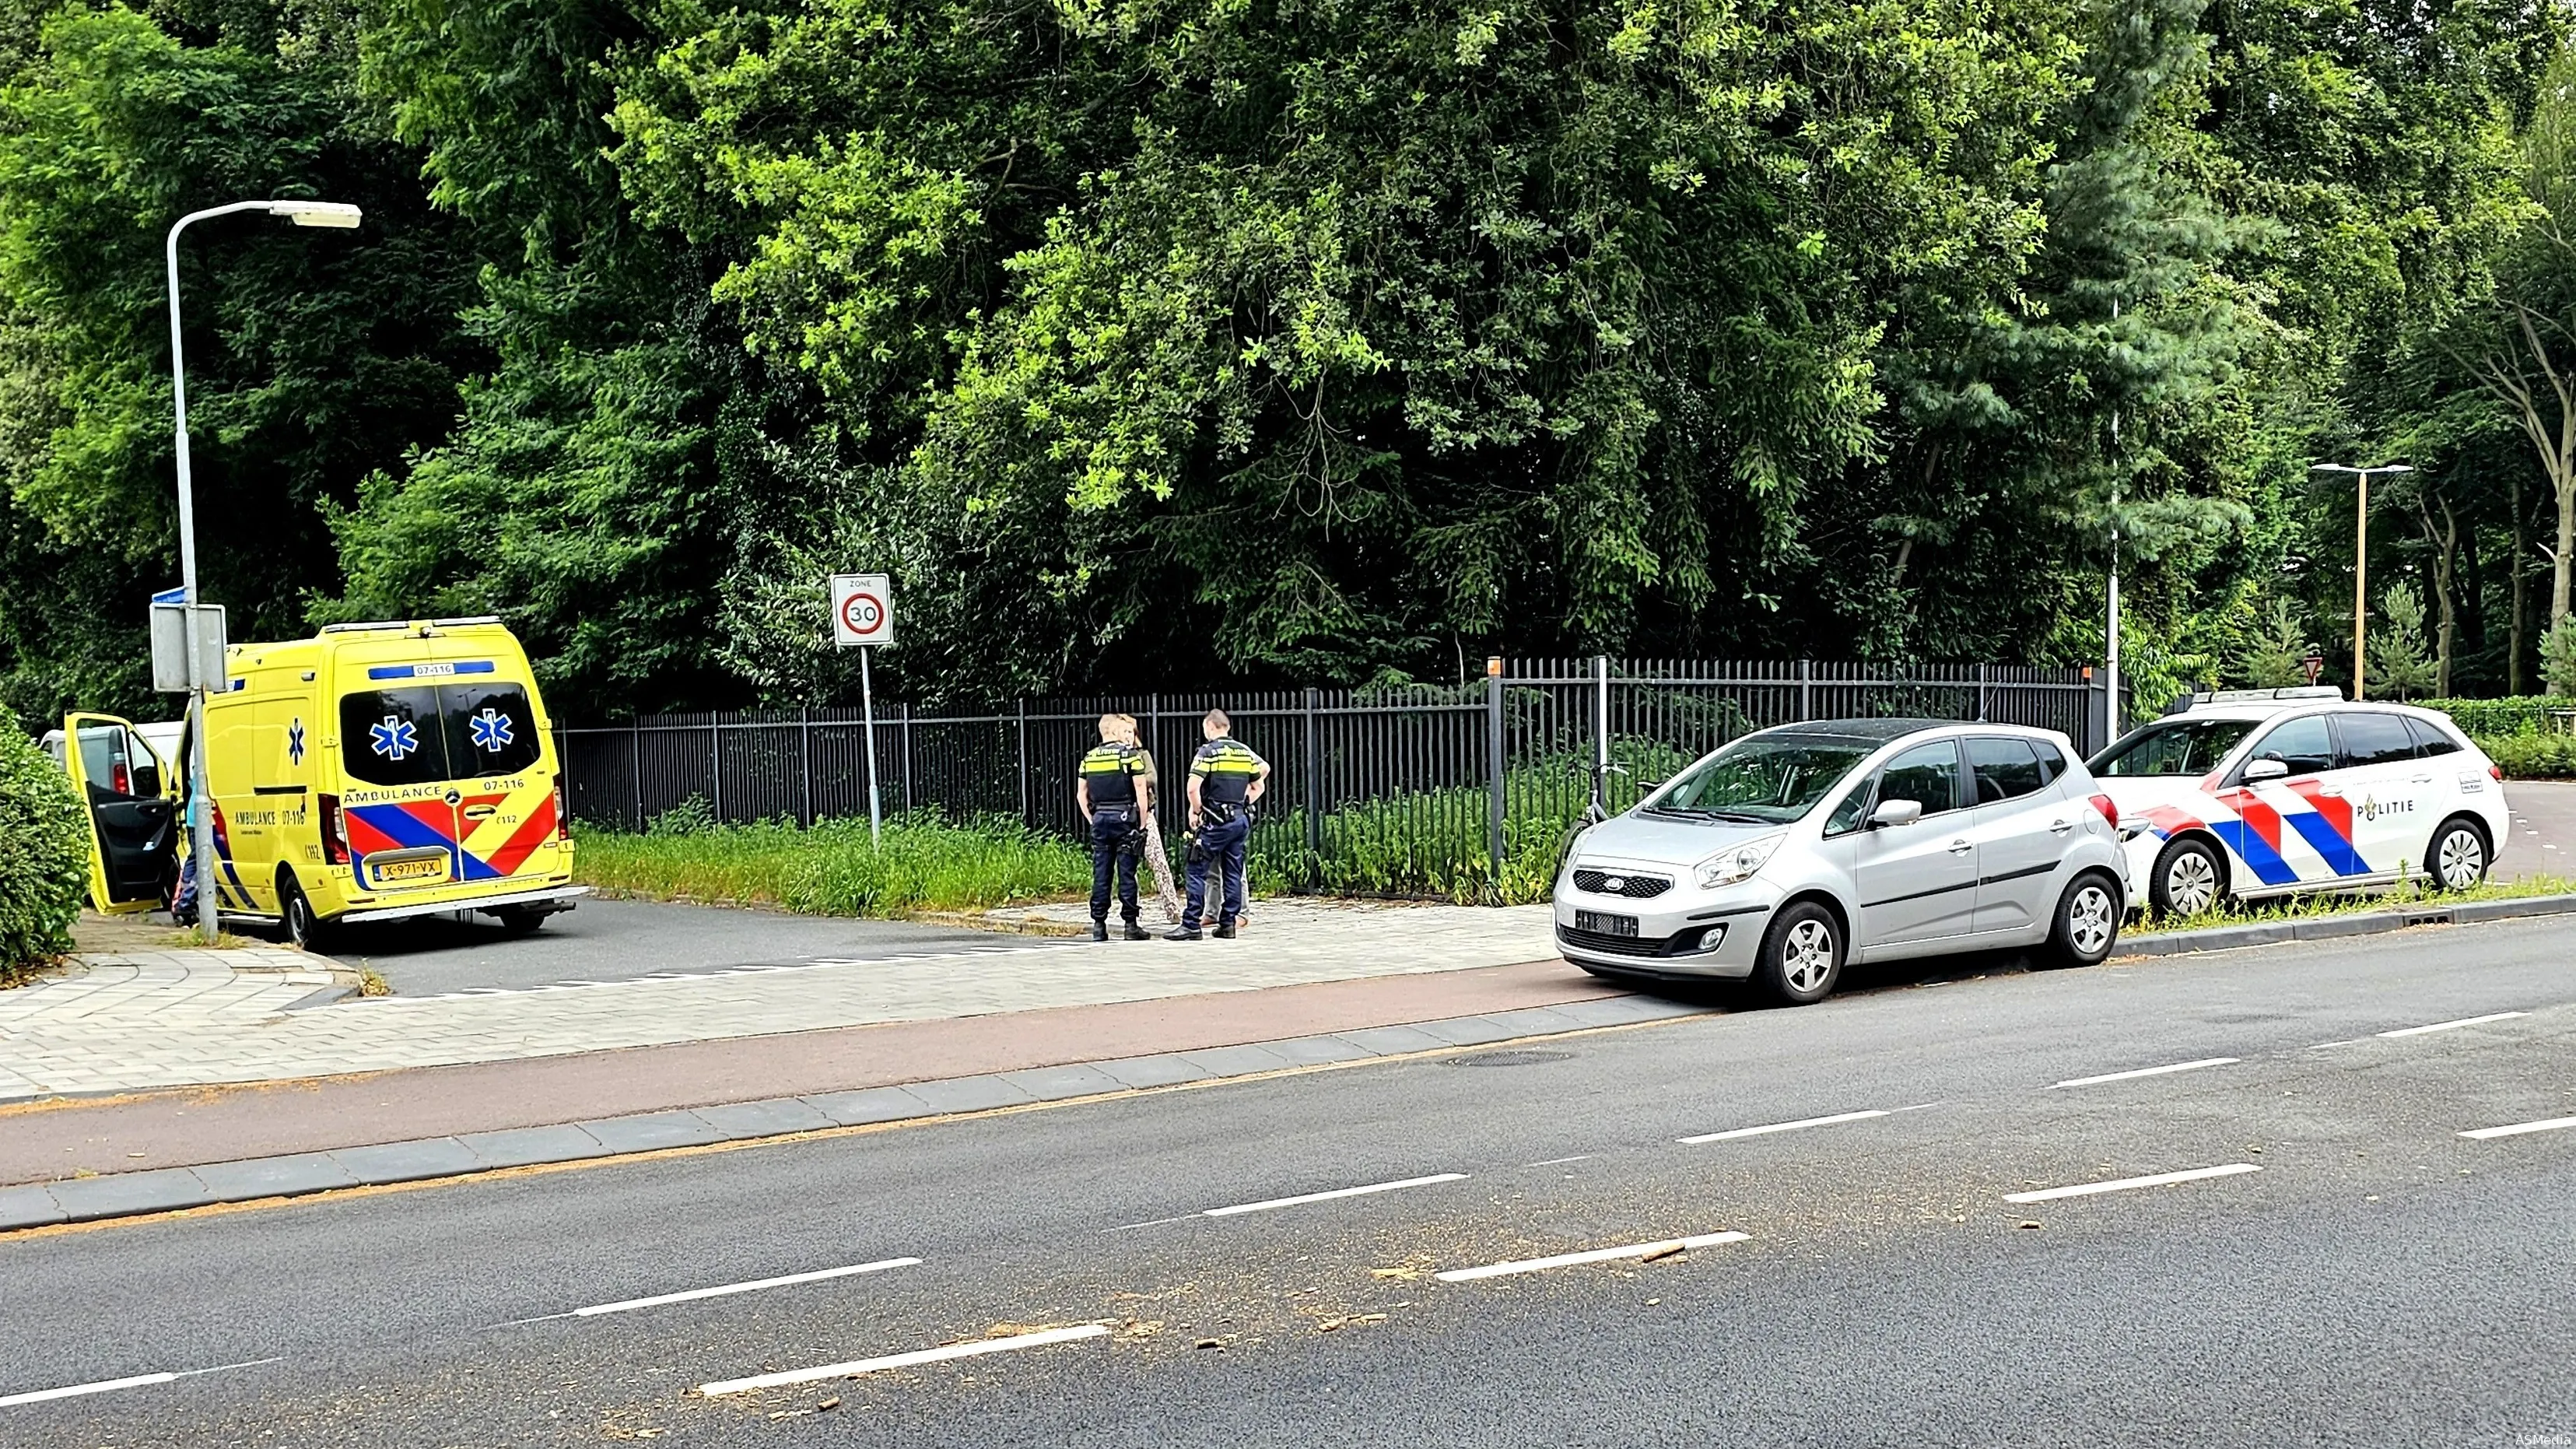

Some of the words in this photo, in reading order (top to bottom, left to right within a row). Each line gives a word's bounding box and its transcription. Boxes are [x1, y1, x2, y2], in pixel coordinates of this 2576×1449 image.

[850, 607, 877, 622] 30
[417, 665, 451, 675] 07-116
[484, 778, 524, 791] 07-116
[344, 786, 442, 803] AMBULANCE
[235, 812, 275, 825] AMBULANCE
[282, 811, 305, 825] 07-116
[2357, 800, 2413, 821] POLITIE
[385, 861, 436, 876] X-971-VX
